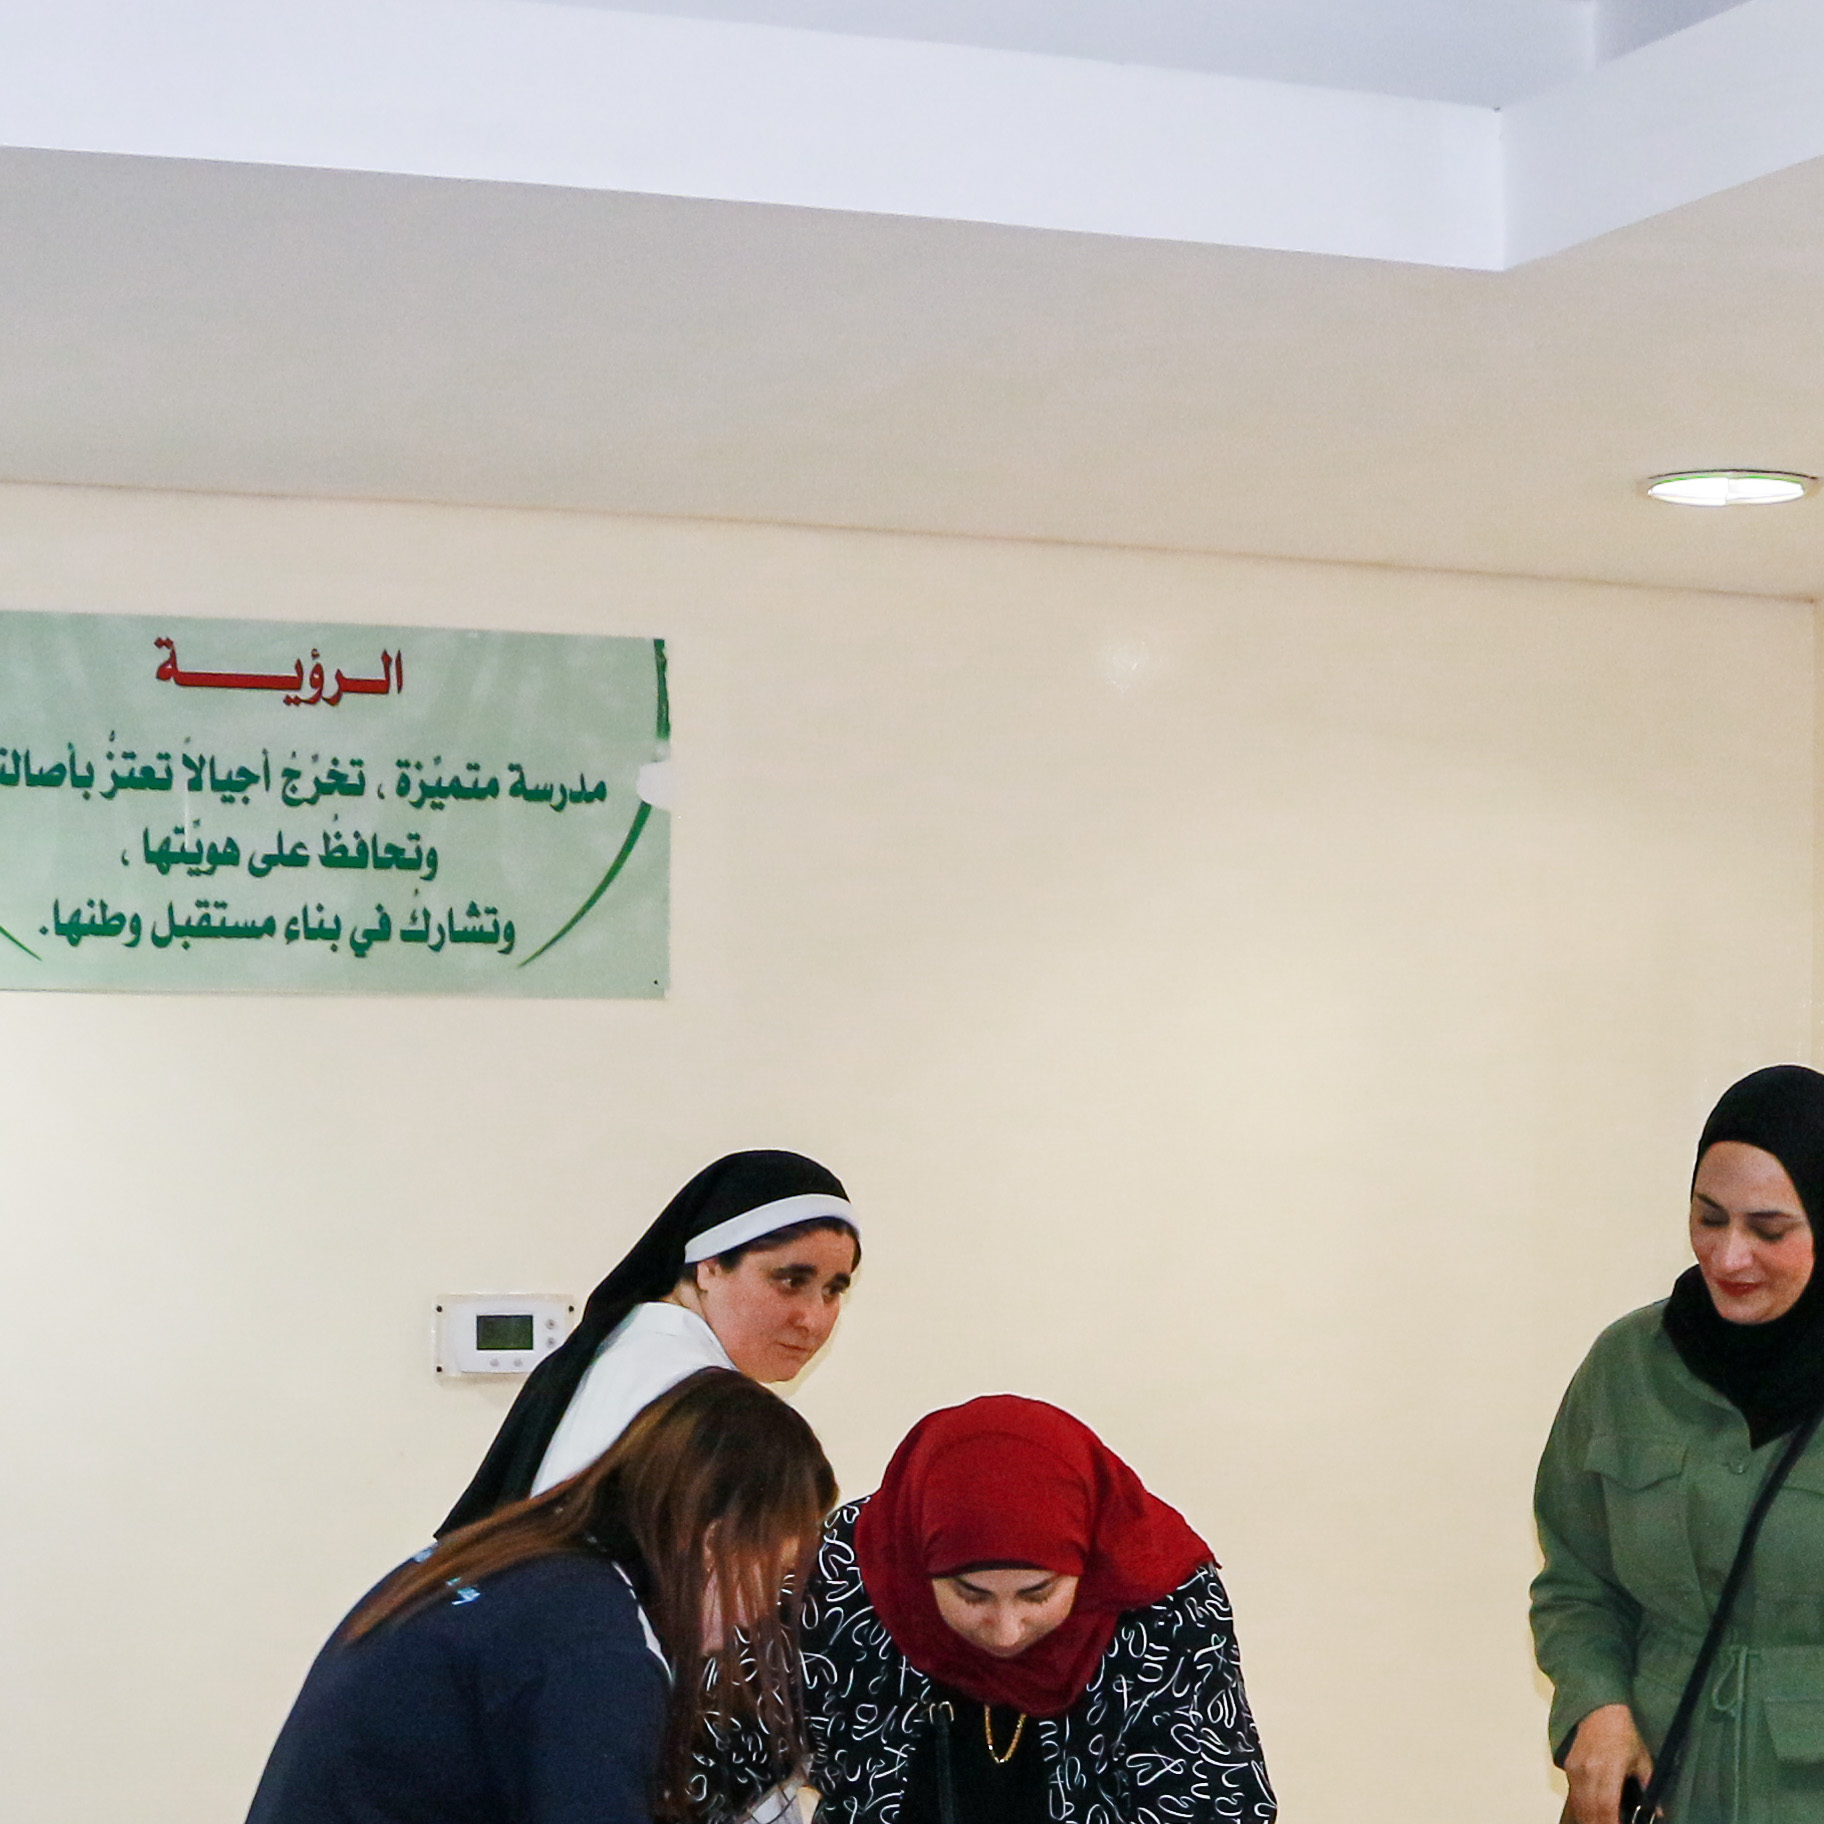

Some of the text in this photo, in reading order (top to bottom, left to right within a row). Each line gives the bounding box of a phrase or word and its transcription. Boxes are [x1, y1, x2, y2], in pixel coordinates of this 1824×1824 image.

[153, 636, 404, 707] الرؤية
[508, 762, 607, 812] مدرسة
[248, 828, 311, 879] على
[150, 898, 277, 951] مستقبل
[284, 901, 343, 954] بناء
[349, 901, 392, 959] في
